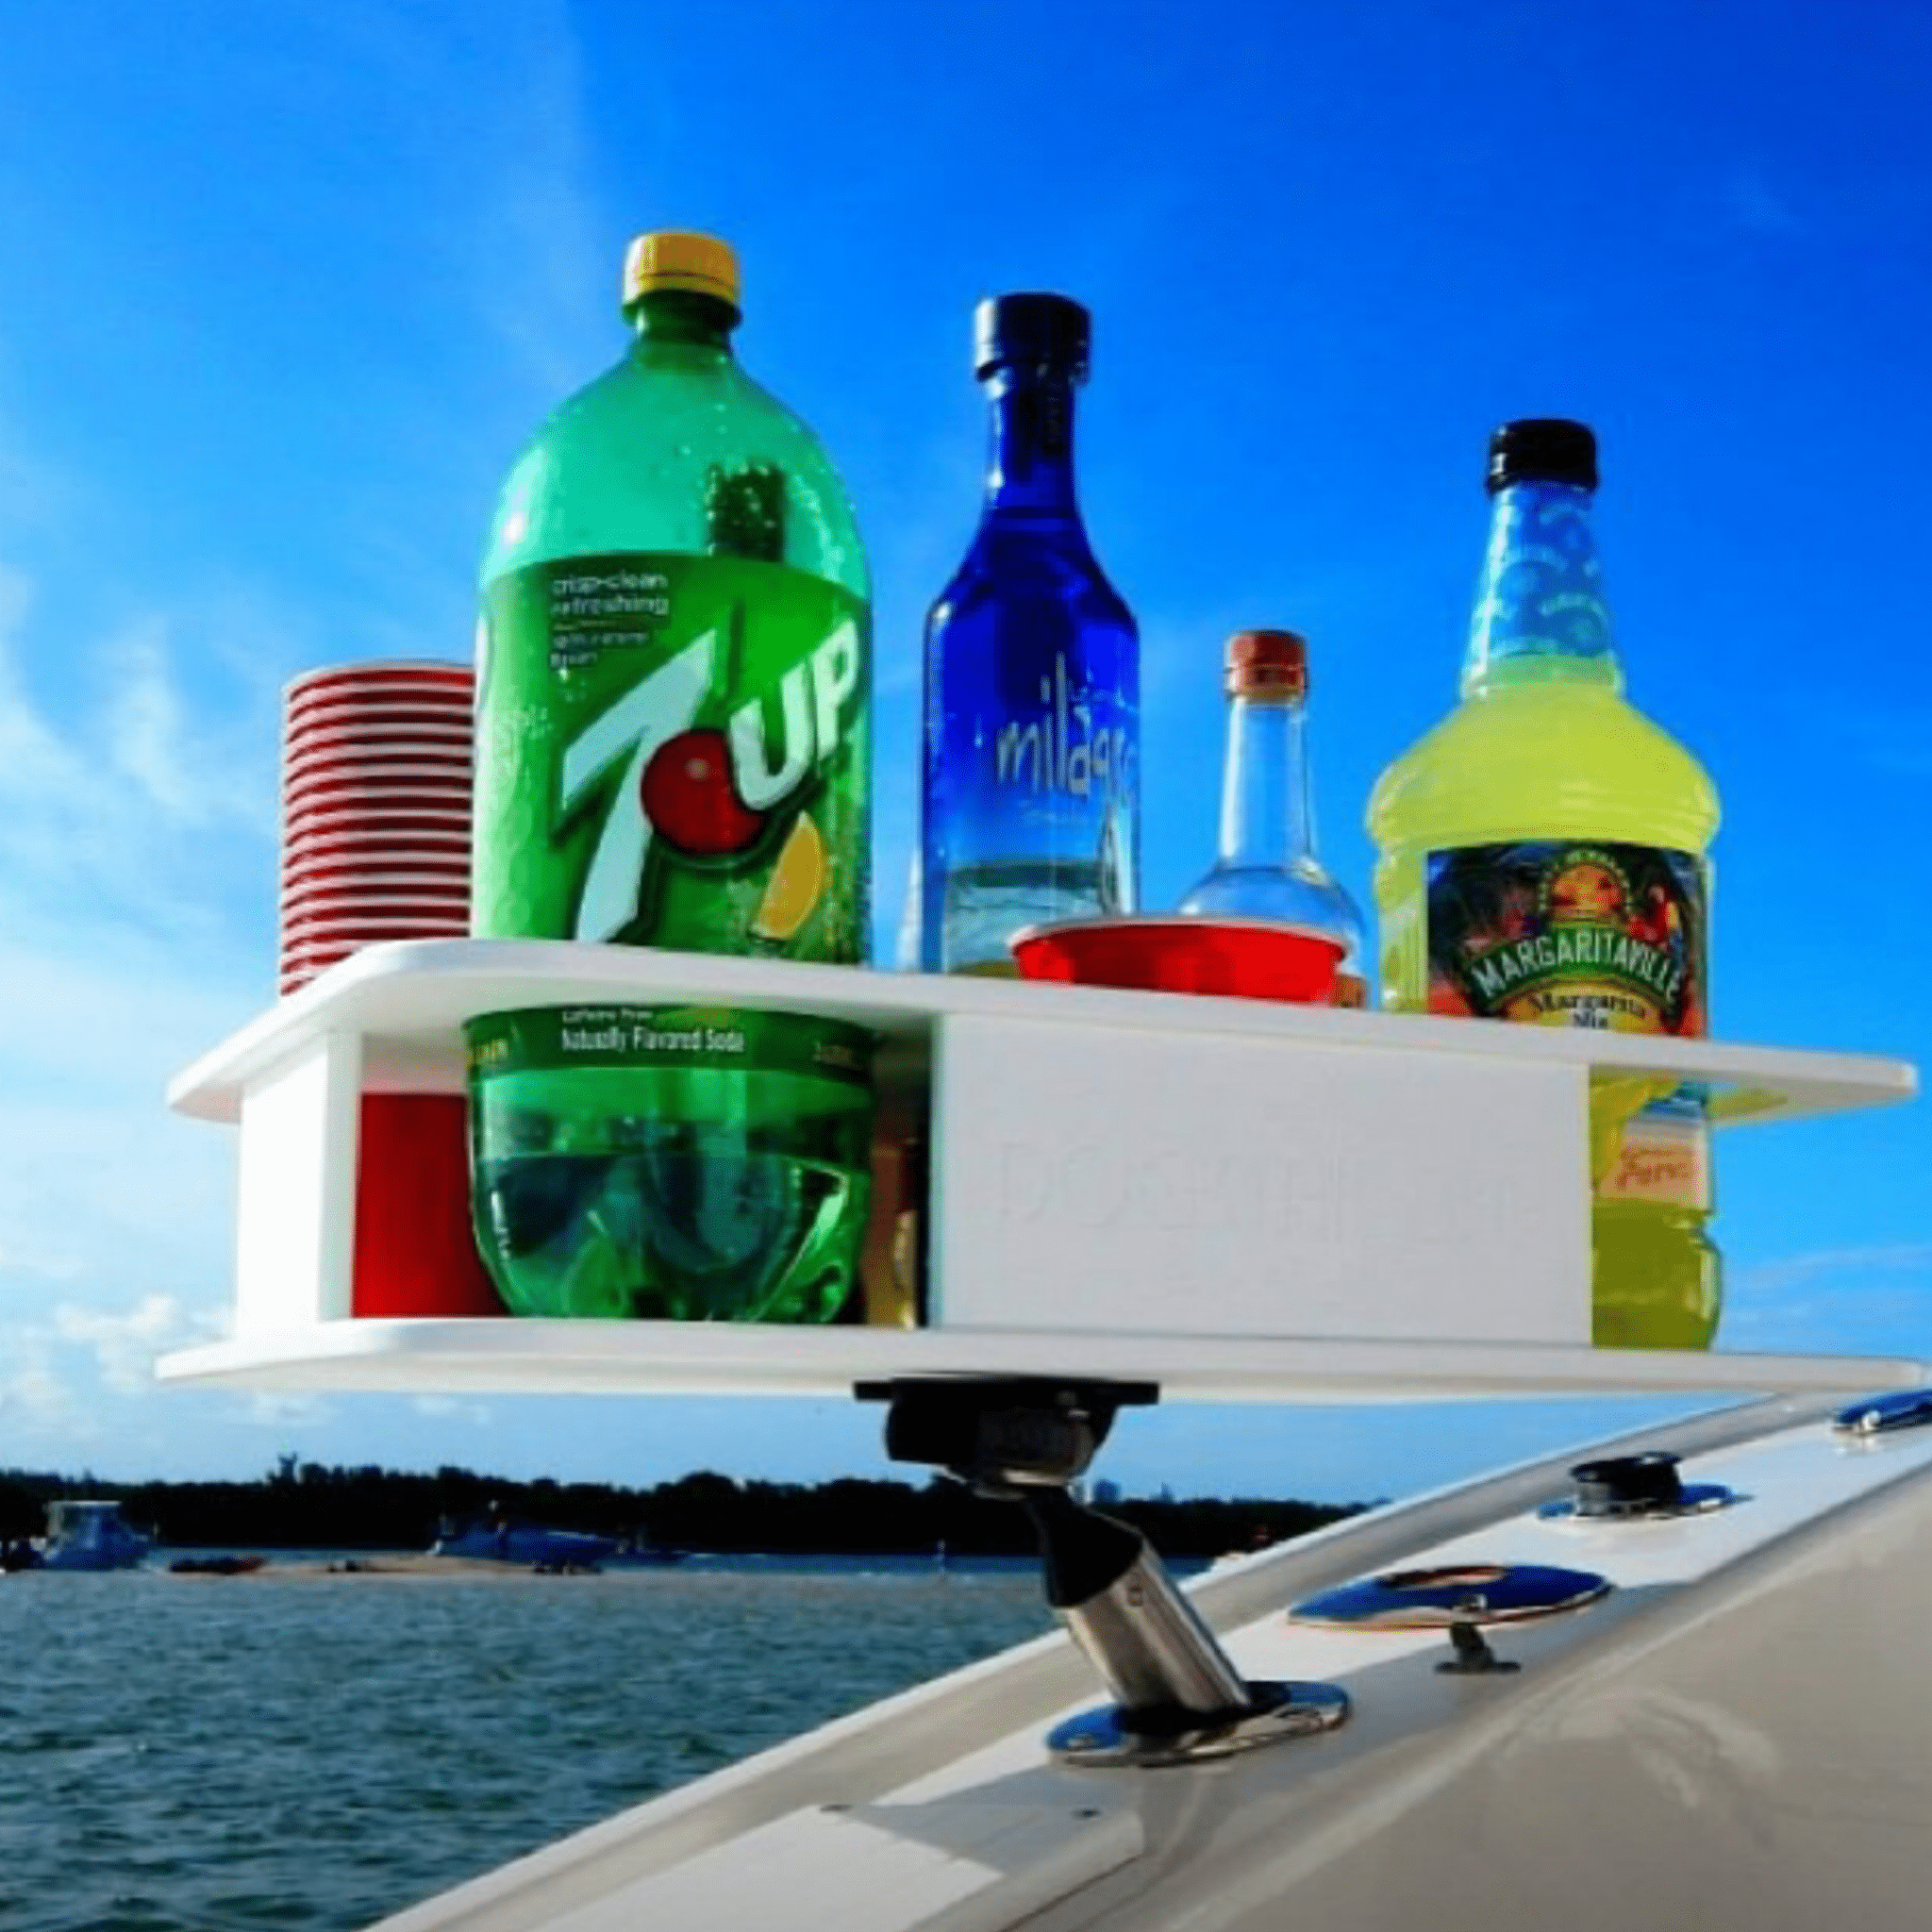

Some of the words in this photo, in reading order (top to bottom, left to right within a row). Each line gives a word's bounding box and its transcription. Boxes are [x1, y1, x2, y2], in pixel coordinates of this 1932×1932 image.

[1470, 928, 1683, 1004] MARGARITAVILLE
[632, 1024, 703, 1052] Flavored
[706, 1027, 745, 1053] Soda
